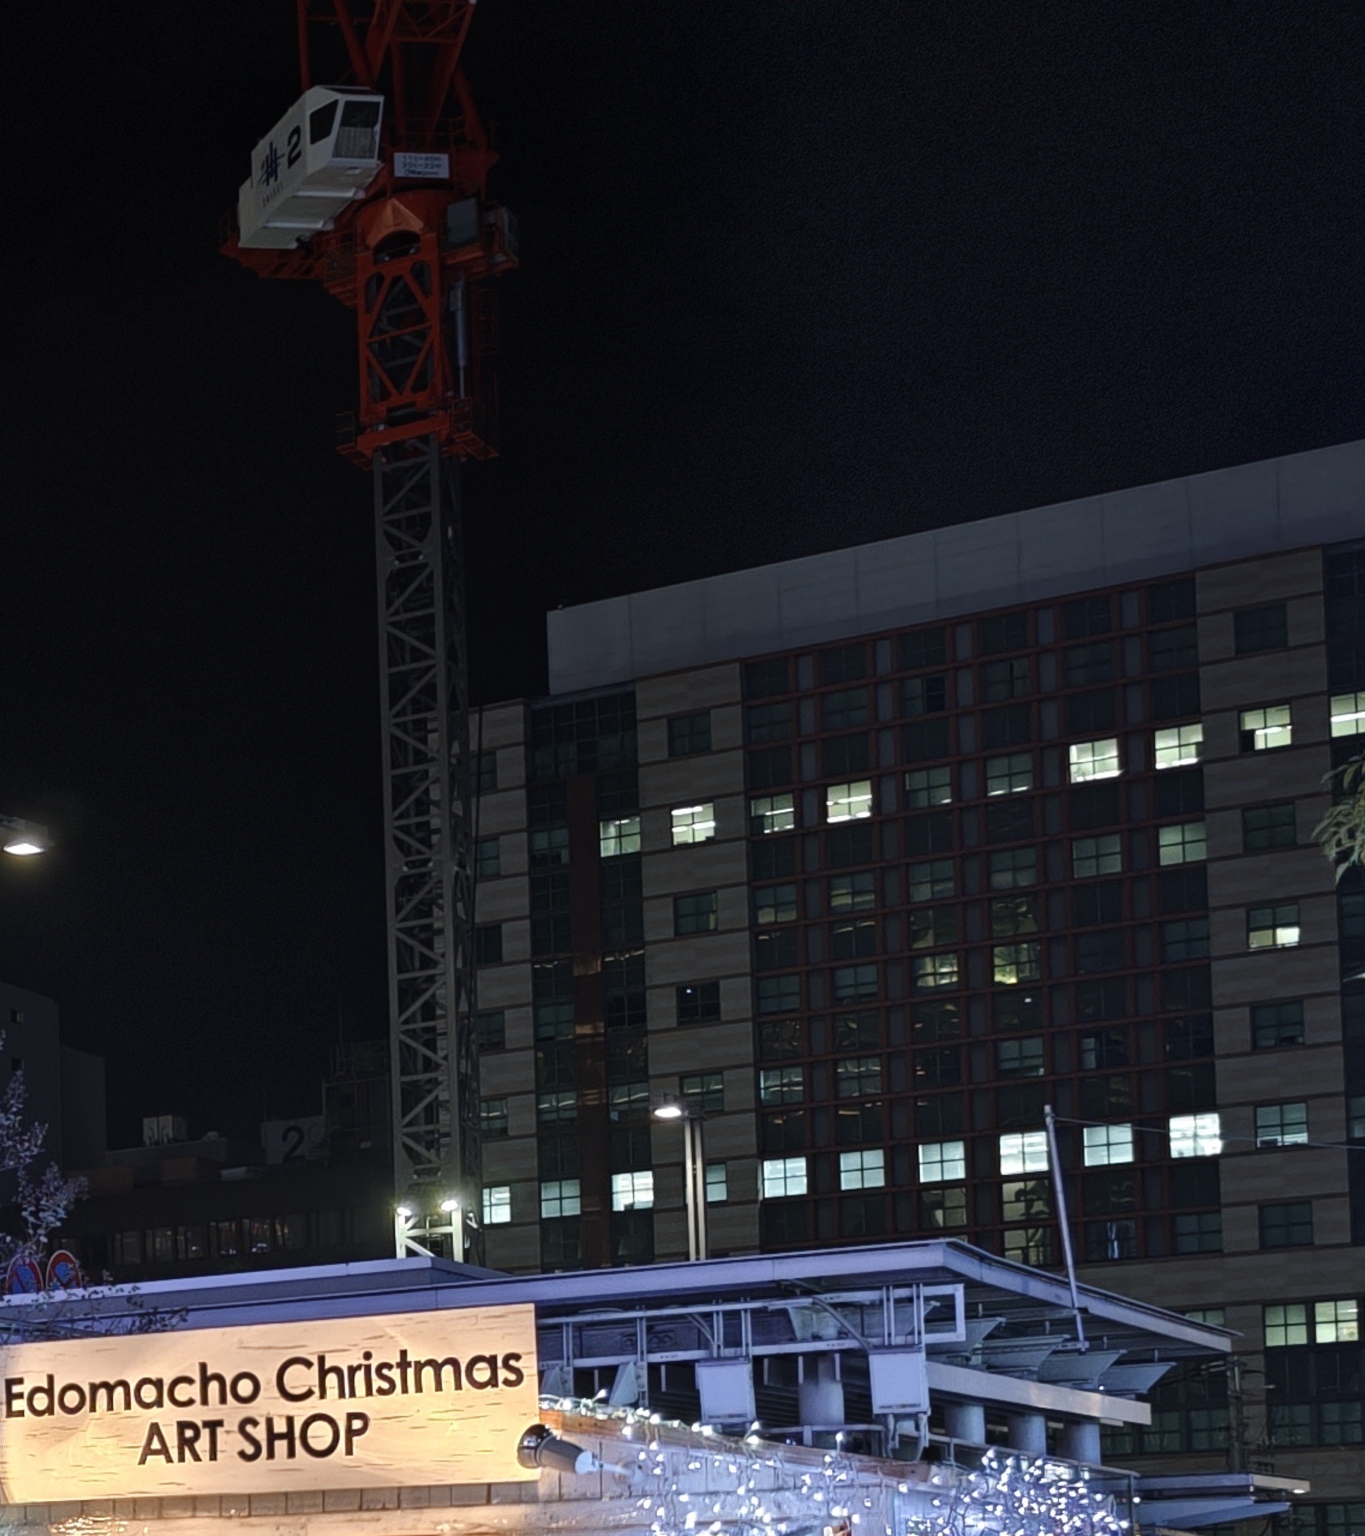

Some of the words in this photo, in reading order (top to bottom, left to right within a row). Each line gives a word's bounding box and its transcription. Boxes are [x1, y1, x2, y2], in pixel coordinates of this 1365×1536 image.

[4, 1361, 261, 1419] Edomacho
[274, 1348, 525, 1403] Christmas
[137, 1417, 221, 1466] ART
[236, 1411, 371, 1463] SHOP
